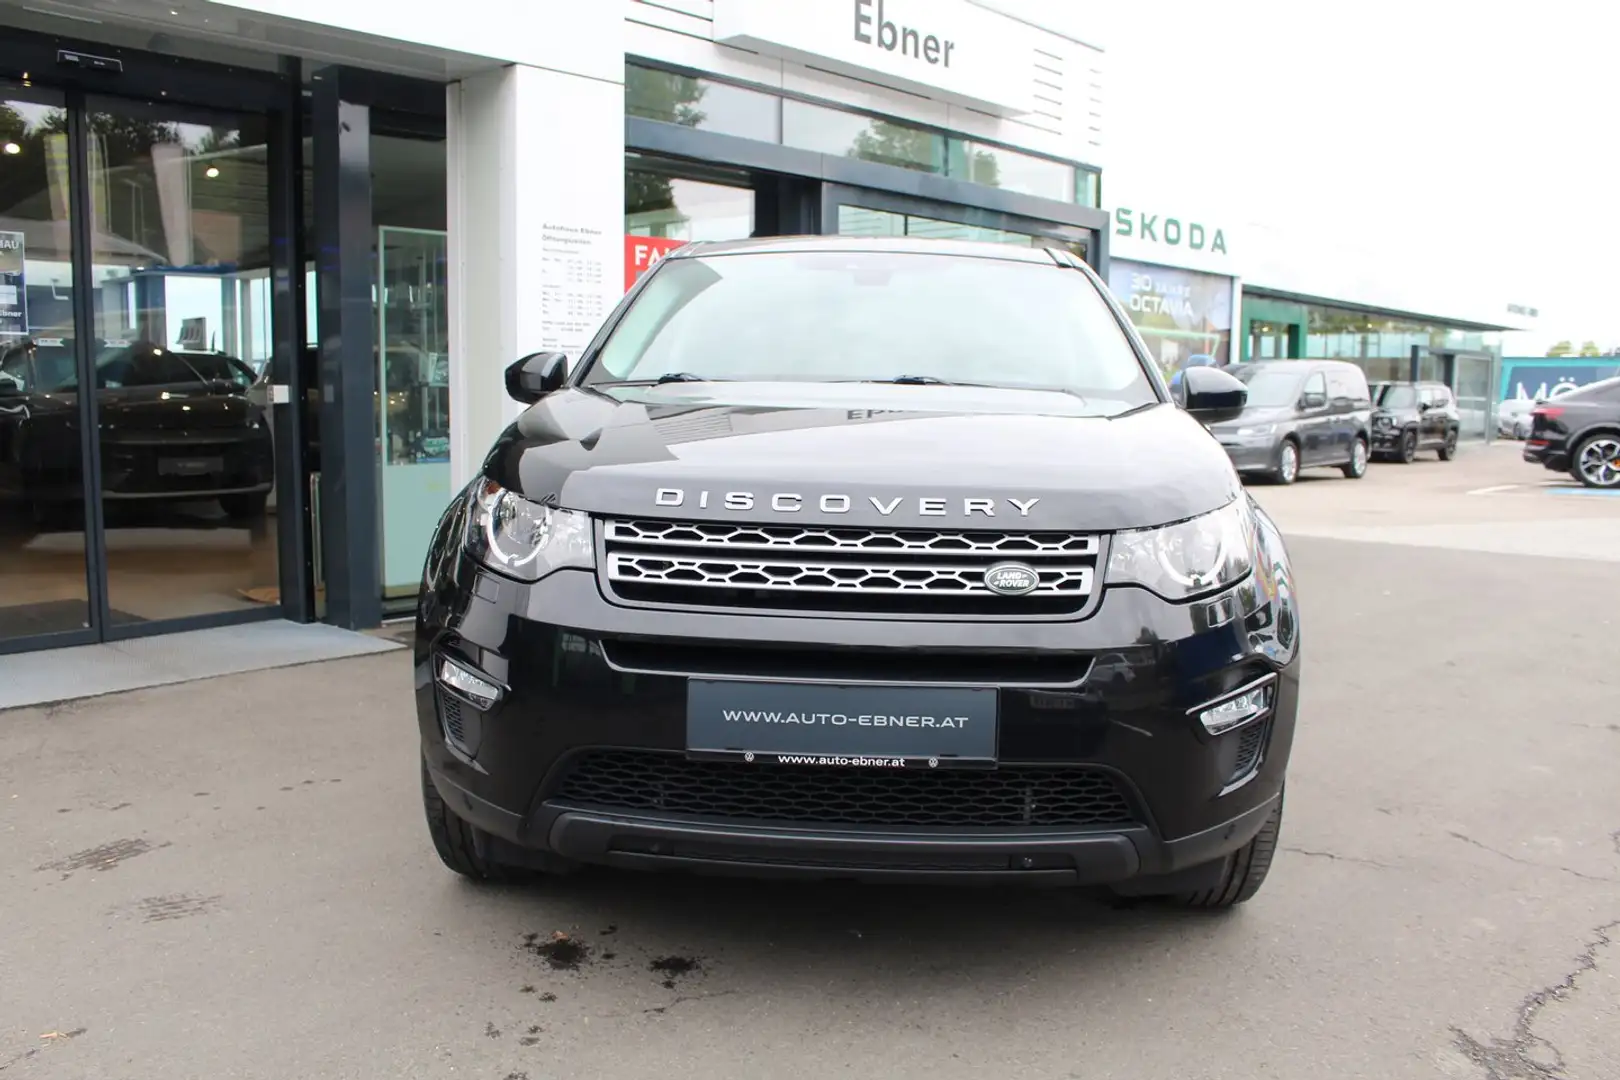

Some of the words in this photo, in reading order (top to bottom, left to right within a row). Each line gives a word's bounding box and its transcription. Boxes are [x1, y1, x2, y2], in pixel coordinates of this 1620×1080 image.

[854, 0, 953, 67] Ebner
[634, 245, 671, 267] FA
[1131, 273, 1152, 291] 30
[1130, 294, 1194, 316] OCTAVIA
[655, 488, 1040, 516] DISCOVERY
[997, 571, 1022, 580] LAND
[999, 579, 1030, 588] ROVER
[722, 710, 969, 728] WWW.AUTO-EBNER.AT
[778, 755, 906, 768] www.auto-ebner.at
